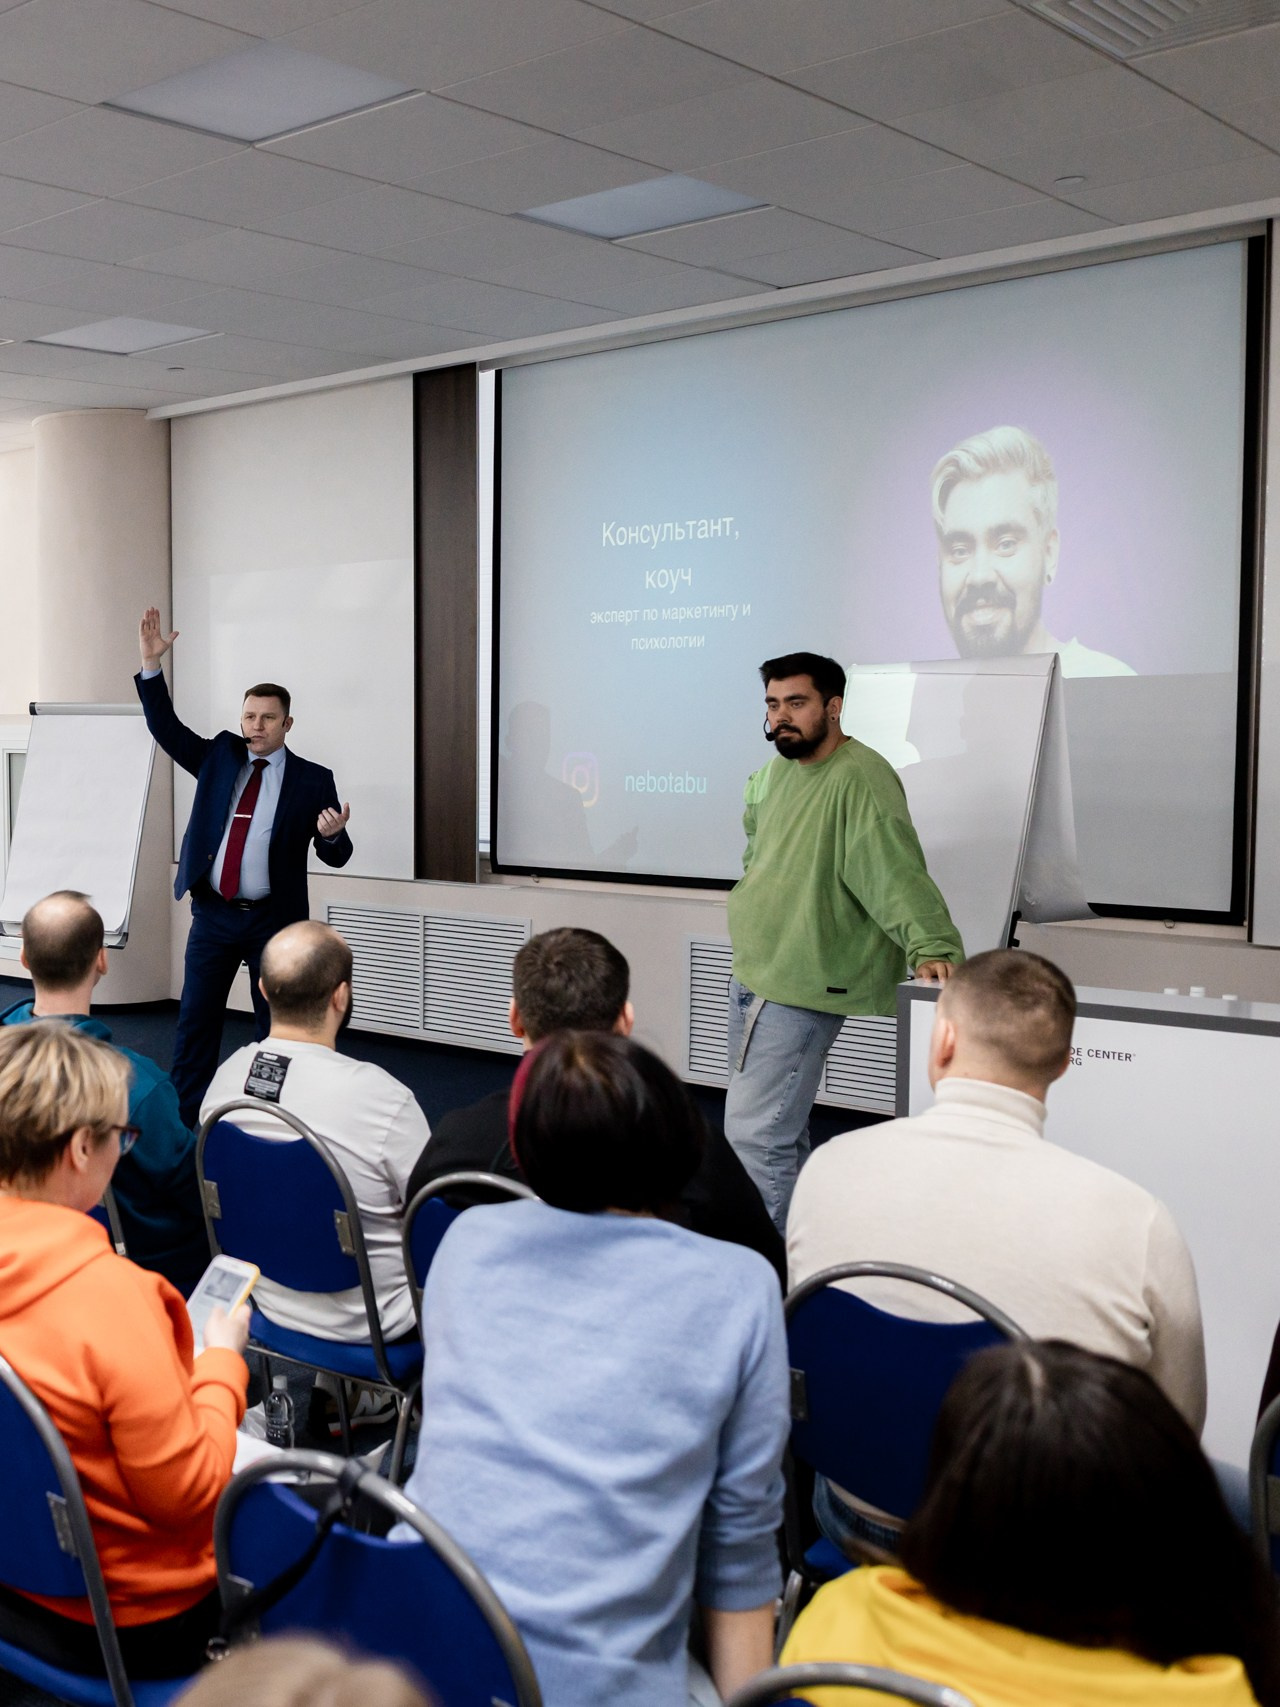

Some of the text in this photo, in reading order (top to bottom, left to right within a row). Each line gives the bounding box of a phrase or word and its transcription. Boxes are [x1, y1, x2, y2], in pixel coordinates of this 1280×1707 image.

[602, 516, 740, 550] Консультант,
[645, 567, 692, 594] коуч
[590, 603, 751, 626] эксперт по маркетингу и
[631, 635, 705, 650] психологии
[625, 770, 707, 794] nebotabu
